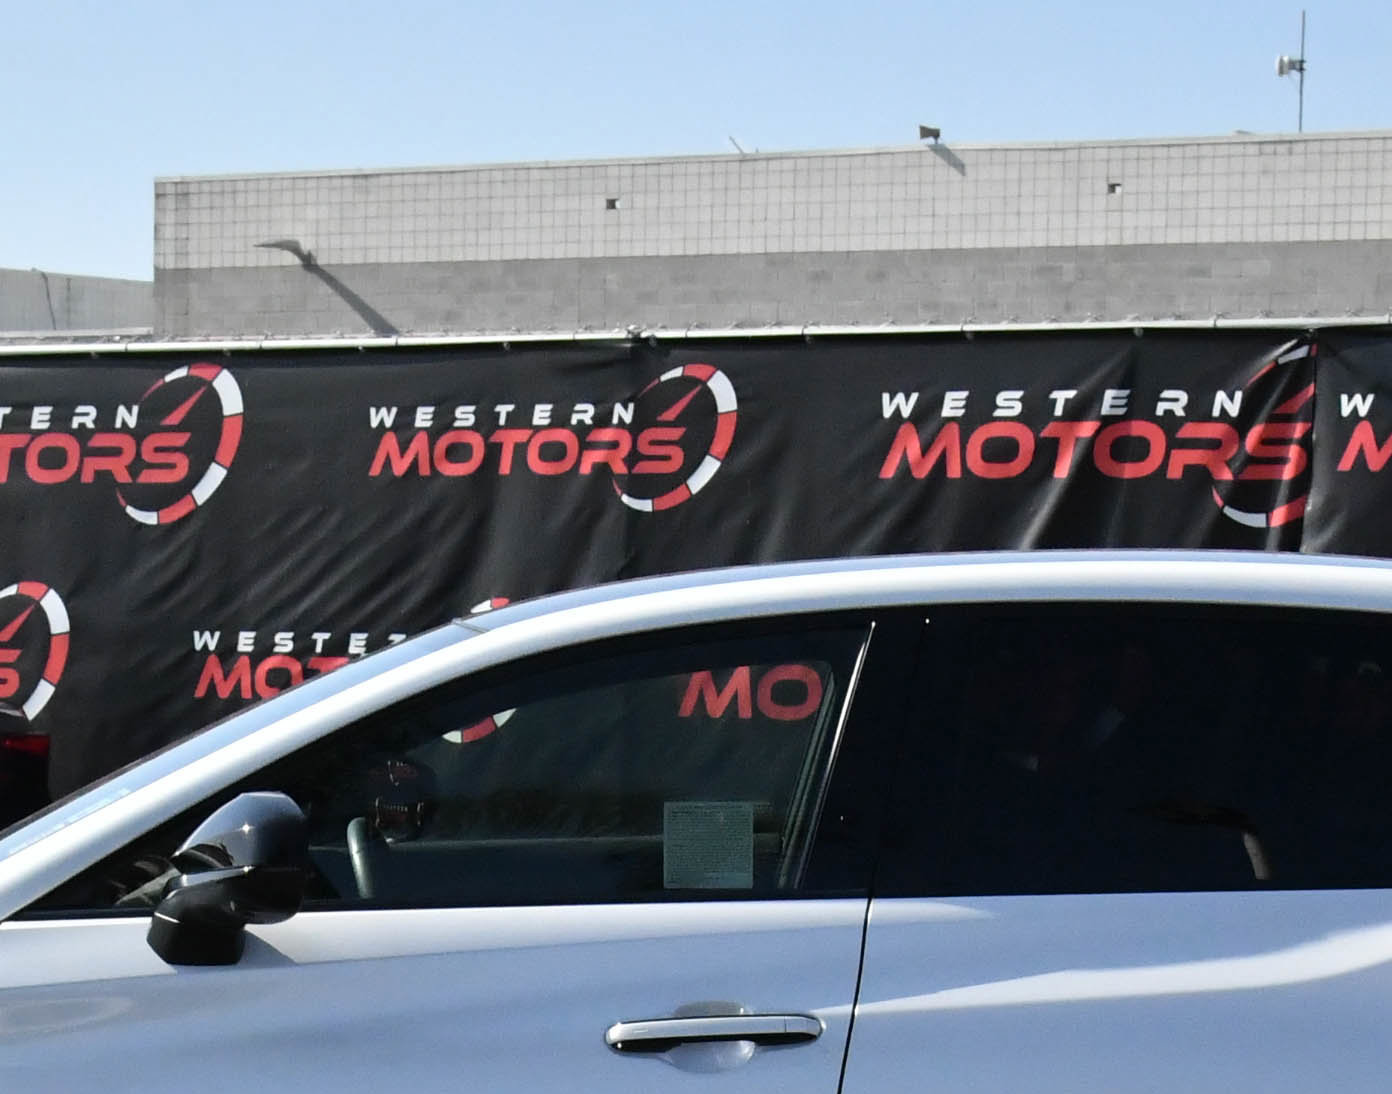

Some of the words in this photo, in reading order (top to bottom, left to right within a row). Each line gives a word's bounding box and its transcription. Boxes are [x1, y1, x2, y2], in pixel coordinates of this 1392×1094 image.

[369, 402, 635, 429] WESTERN
[881, 389, 1243, 419] WESTERN
[368, 426, 687, 478] MOTORS
[879, 419, 1312, 481] MOTORS
